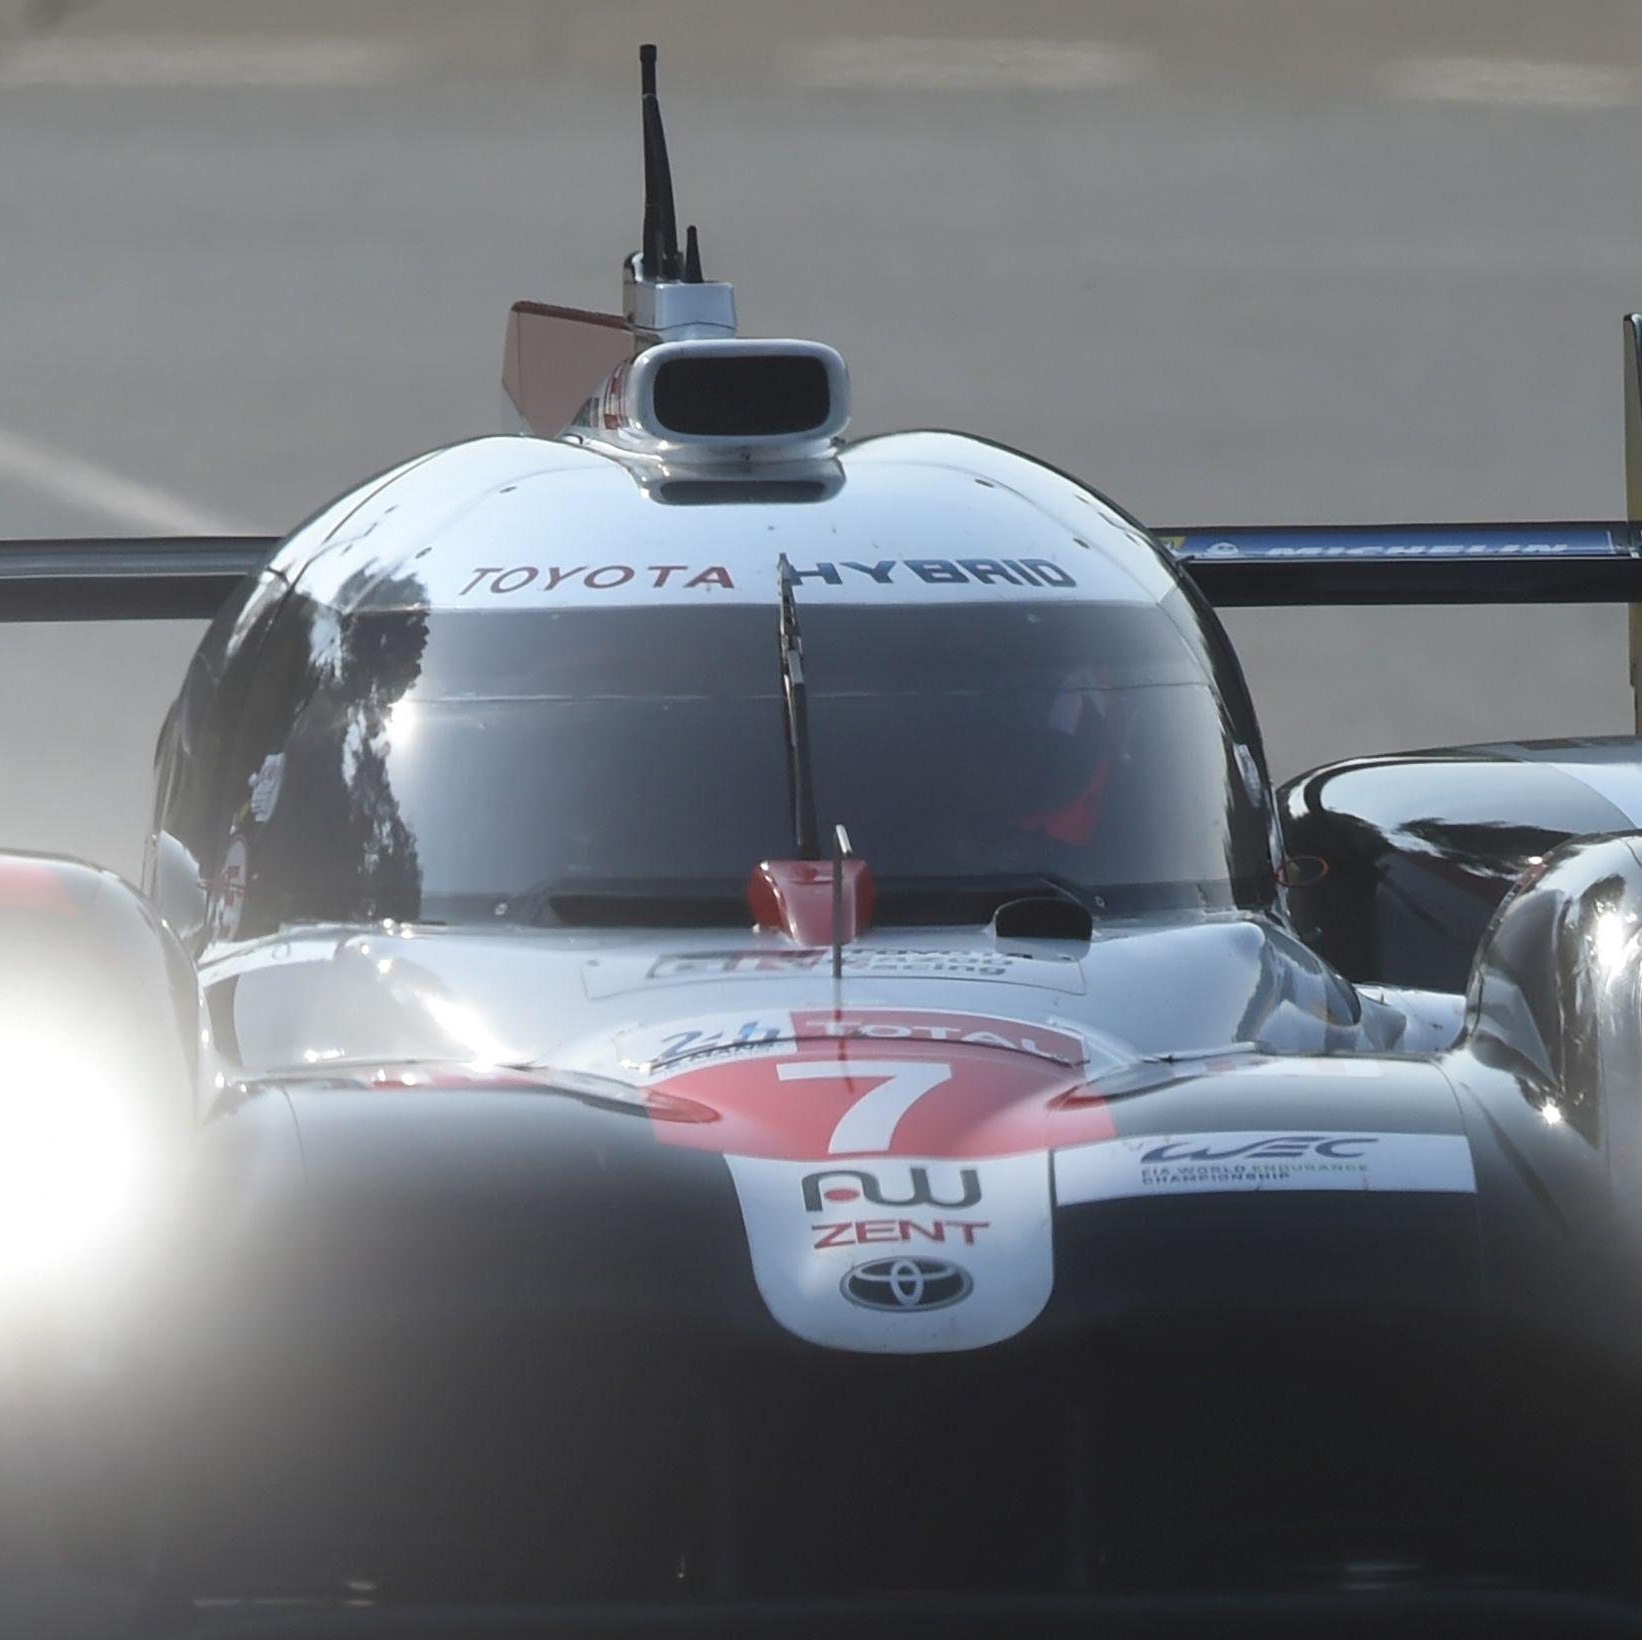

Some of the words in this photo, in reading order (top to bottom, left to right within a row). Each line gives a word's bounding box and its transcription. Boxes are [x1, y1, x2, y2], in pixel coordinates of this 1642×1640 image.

[1265, 543, 1569, 557] MICHELIN
[458, 565, 735, 596] TOYOTA
[790, 558, 1078, 588] HYBRID
[805, 1021, 1071, 1064] TOTAL
[777, 1061, 952, 1154] 7
[1140, 1136, 1379, 1164] WEC
[1141, 1172, 1290, 1186] CHAMPIONSHIP
[1178, 1165, 1246, 1176] WORLD
[1251, 1163, 1370, 1173] ENDURANCE
[811, 1219, 990, 1250] ZENT
